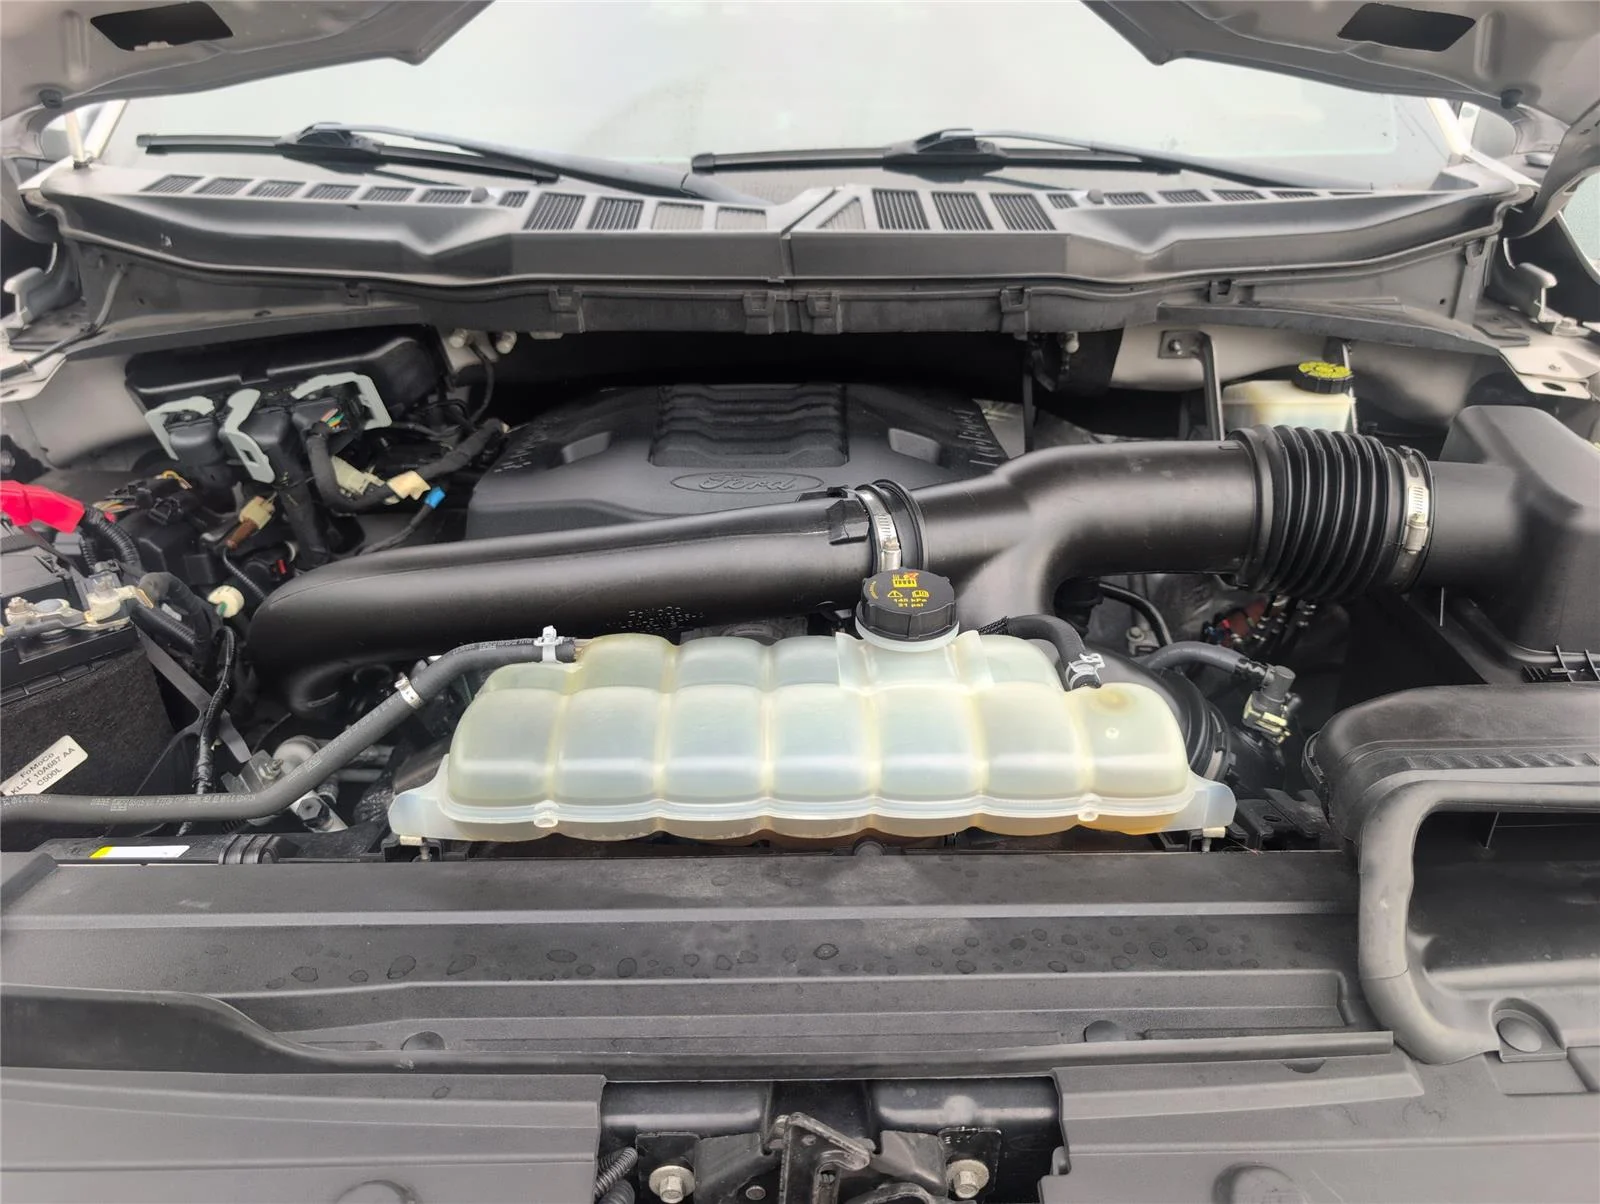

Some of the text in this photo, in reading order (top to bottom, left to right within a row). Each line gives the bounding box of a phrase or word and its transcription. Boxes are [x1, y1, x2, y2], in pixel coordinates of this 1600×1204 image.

[699, 474, 797, 490] Ford
[63, 747, 75, 758] AA
[21, 752, 54, 778] FoMoCo
